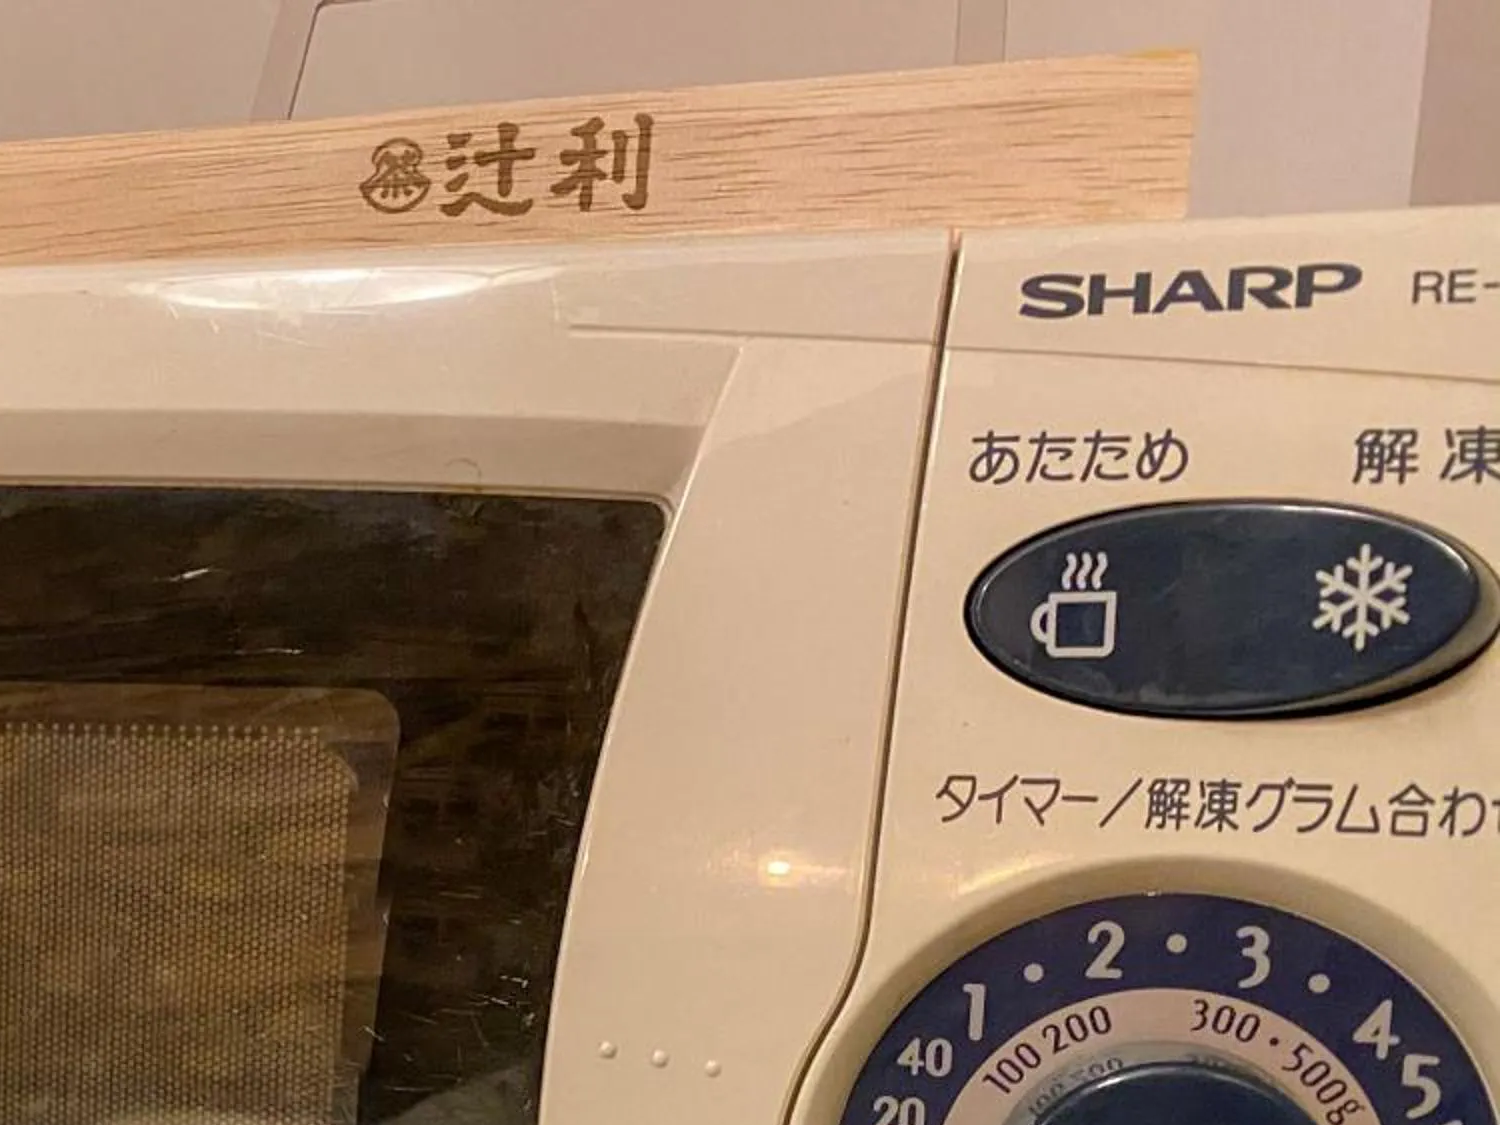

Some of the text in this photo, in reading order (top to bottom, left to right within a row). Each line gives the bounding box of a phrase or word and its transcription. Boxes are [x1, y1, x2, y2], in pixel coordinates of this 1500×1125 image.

[439, 112, 655, 217] 辻利
[1018, 263, 1363, 319] SHARP
[968, 428, 1190, 485] あたため
[935, 774, 1500, 838] タイマー/解凍グラム合わ
[1086, 920, 1126, 980] 2
[1235, 925, 1271, 988] 3
[963, 983, 987, 1041] 1
[1190, 1000, 1261, 1043] 300
[1352, 999, 1400, 1060] 4
[896, 1037, 953, 1078] 40
[982, 1042, 1042, 1095] 100
[1041, 1005, 1113, 1055] 200
[1401, 1054, 1442, 1119] 5
